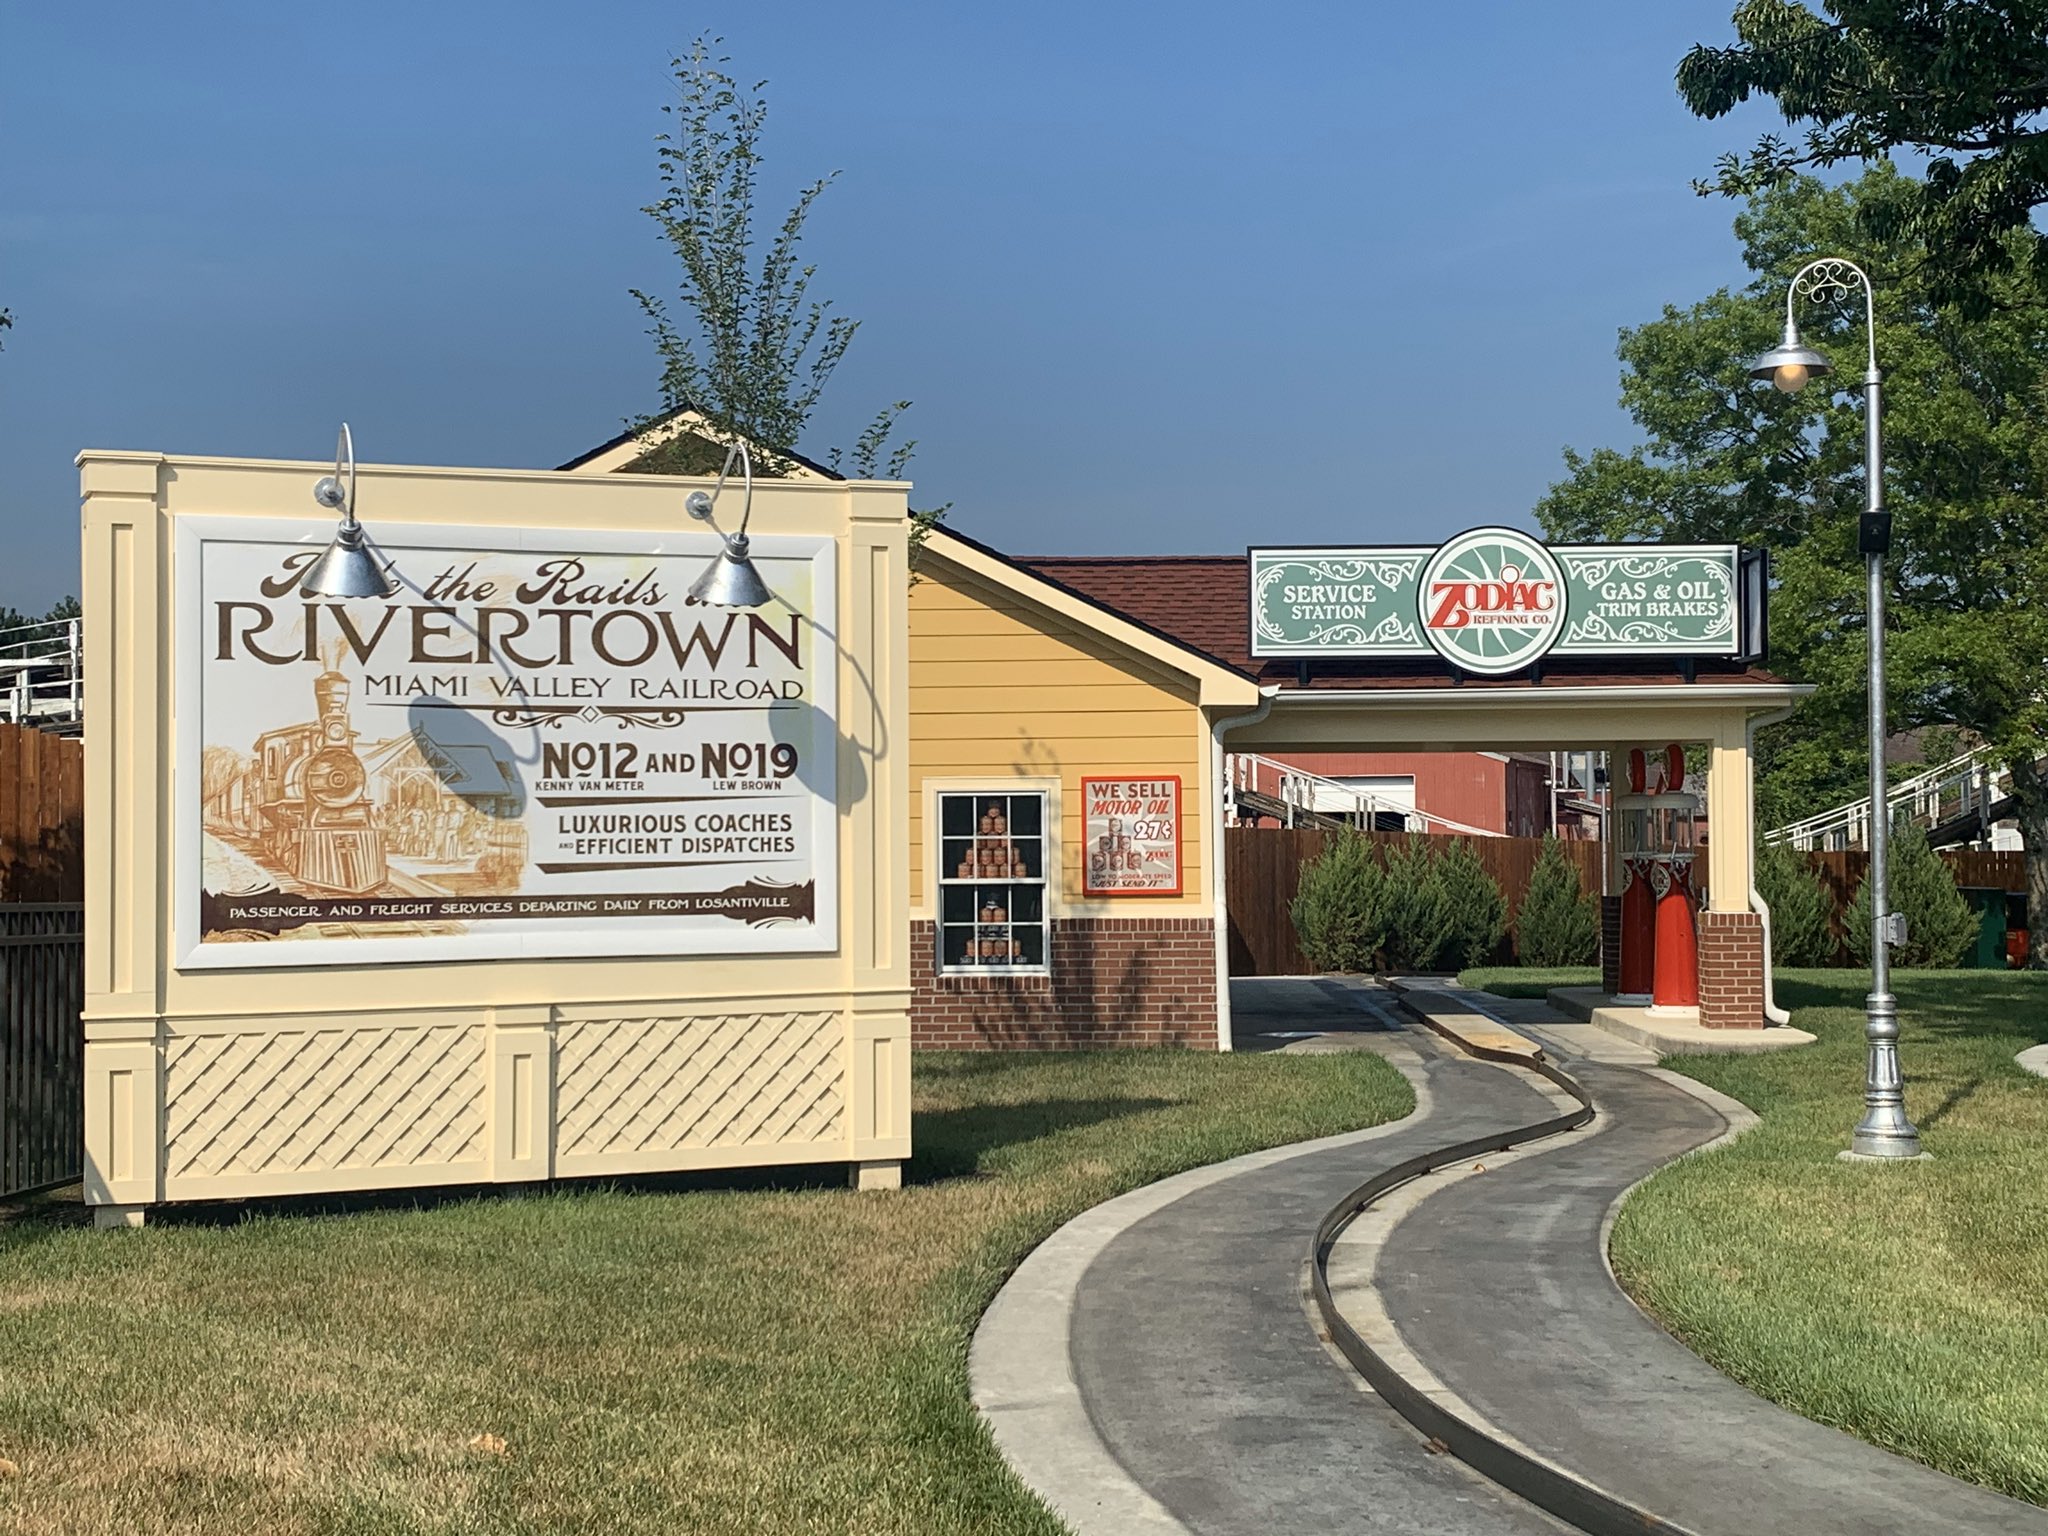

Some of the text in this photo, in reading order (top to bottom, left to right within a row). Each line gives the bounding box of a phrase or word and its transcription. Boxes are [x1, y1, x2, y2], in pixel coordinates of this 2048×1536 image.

[423, 561, 498, 601] the
[516, 556, 668, 605] Rails
[1283, 584, 1377, 604] SERVICE
[1428, 564, 1554, 628] ZODIAC
[1601, 581, 1717, 600] GAS & OIL
[1291, 604, 1367, 620] STATION
[1596, 601, 1719, 617] TRIM BRAKES
[1473, 614, 1553, 625] REFINING CO.
[214, 600, 804, 672] RIVERTOWN
[364, 674, 804, 700] MIAMI VALLEY RAILROAD
[645, 753, 696, 773] AND
[535, 781, 645, 791] KENNY VAN METER
[713, 780, 782, 790] LEW BROWN
[1091, 783, 1171, 798] WE SELL
[1090, 799, 1170, 816] MOTOR OIL
[558, 813, 793, 834] LUXURIOUS COACHES
[1134, 820, 1173, 841] 27¢
[575, 838, 673, 855] EFFICIENT
[682, 836, 795, 853] DISPATCHES
[229, 896, 791, 919] PASSENGER AND FREIGHT SERVICES DEPARTING DAILY FROM LOSANTIVILLE
